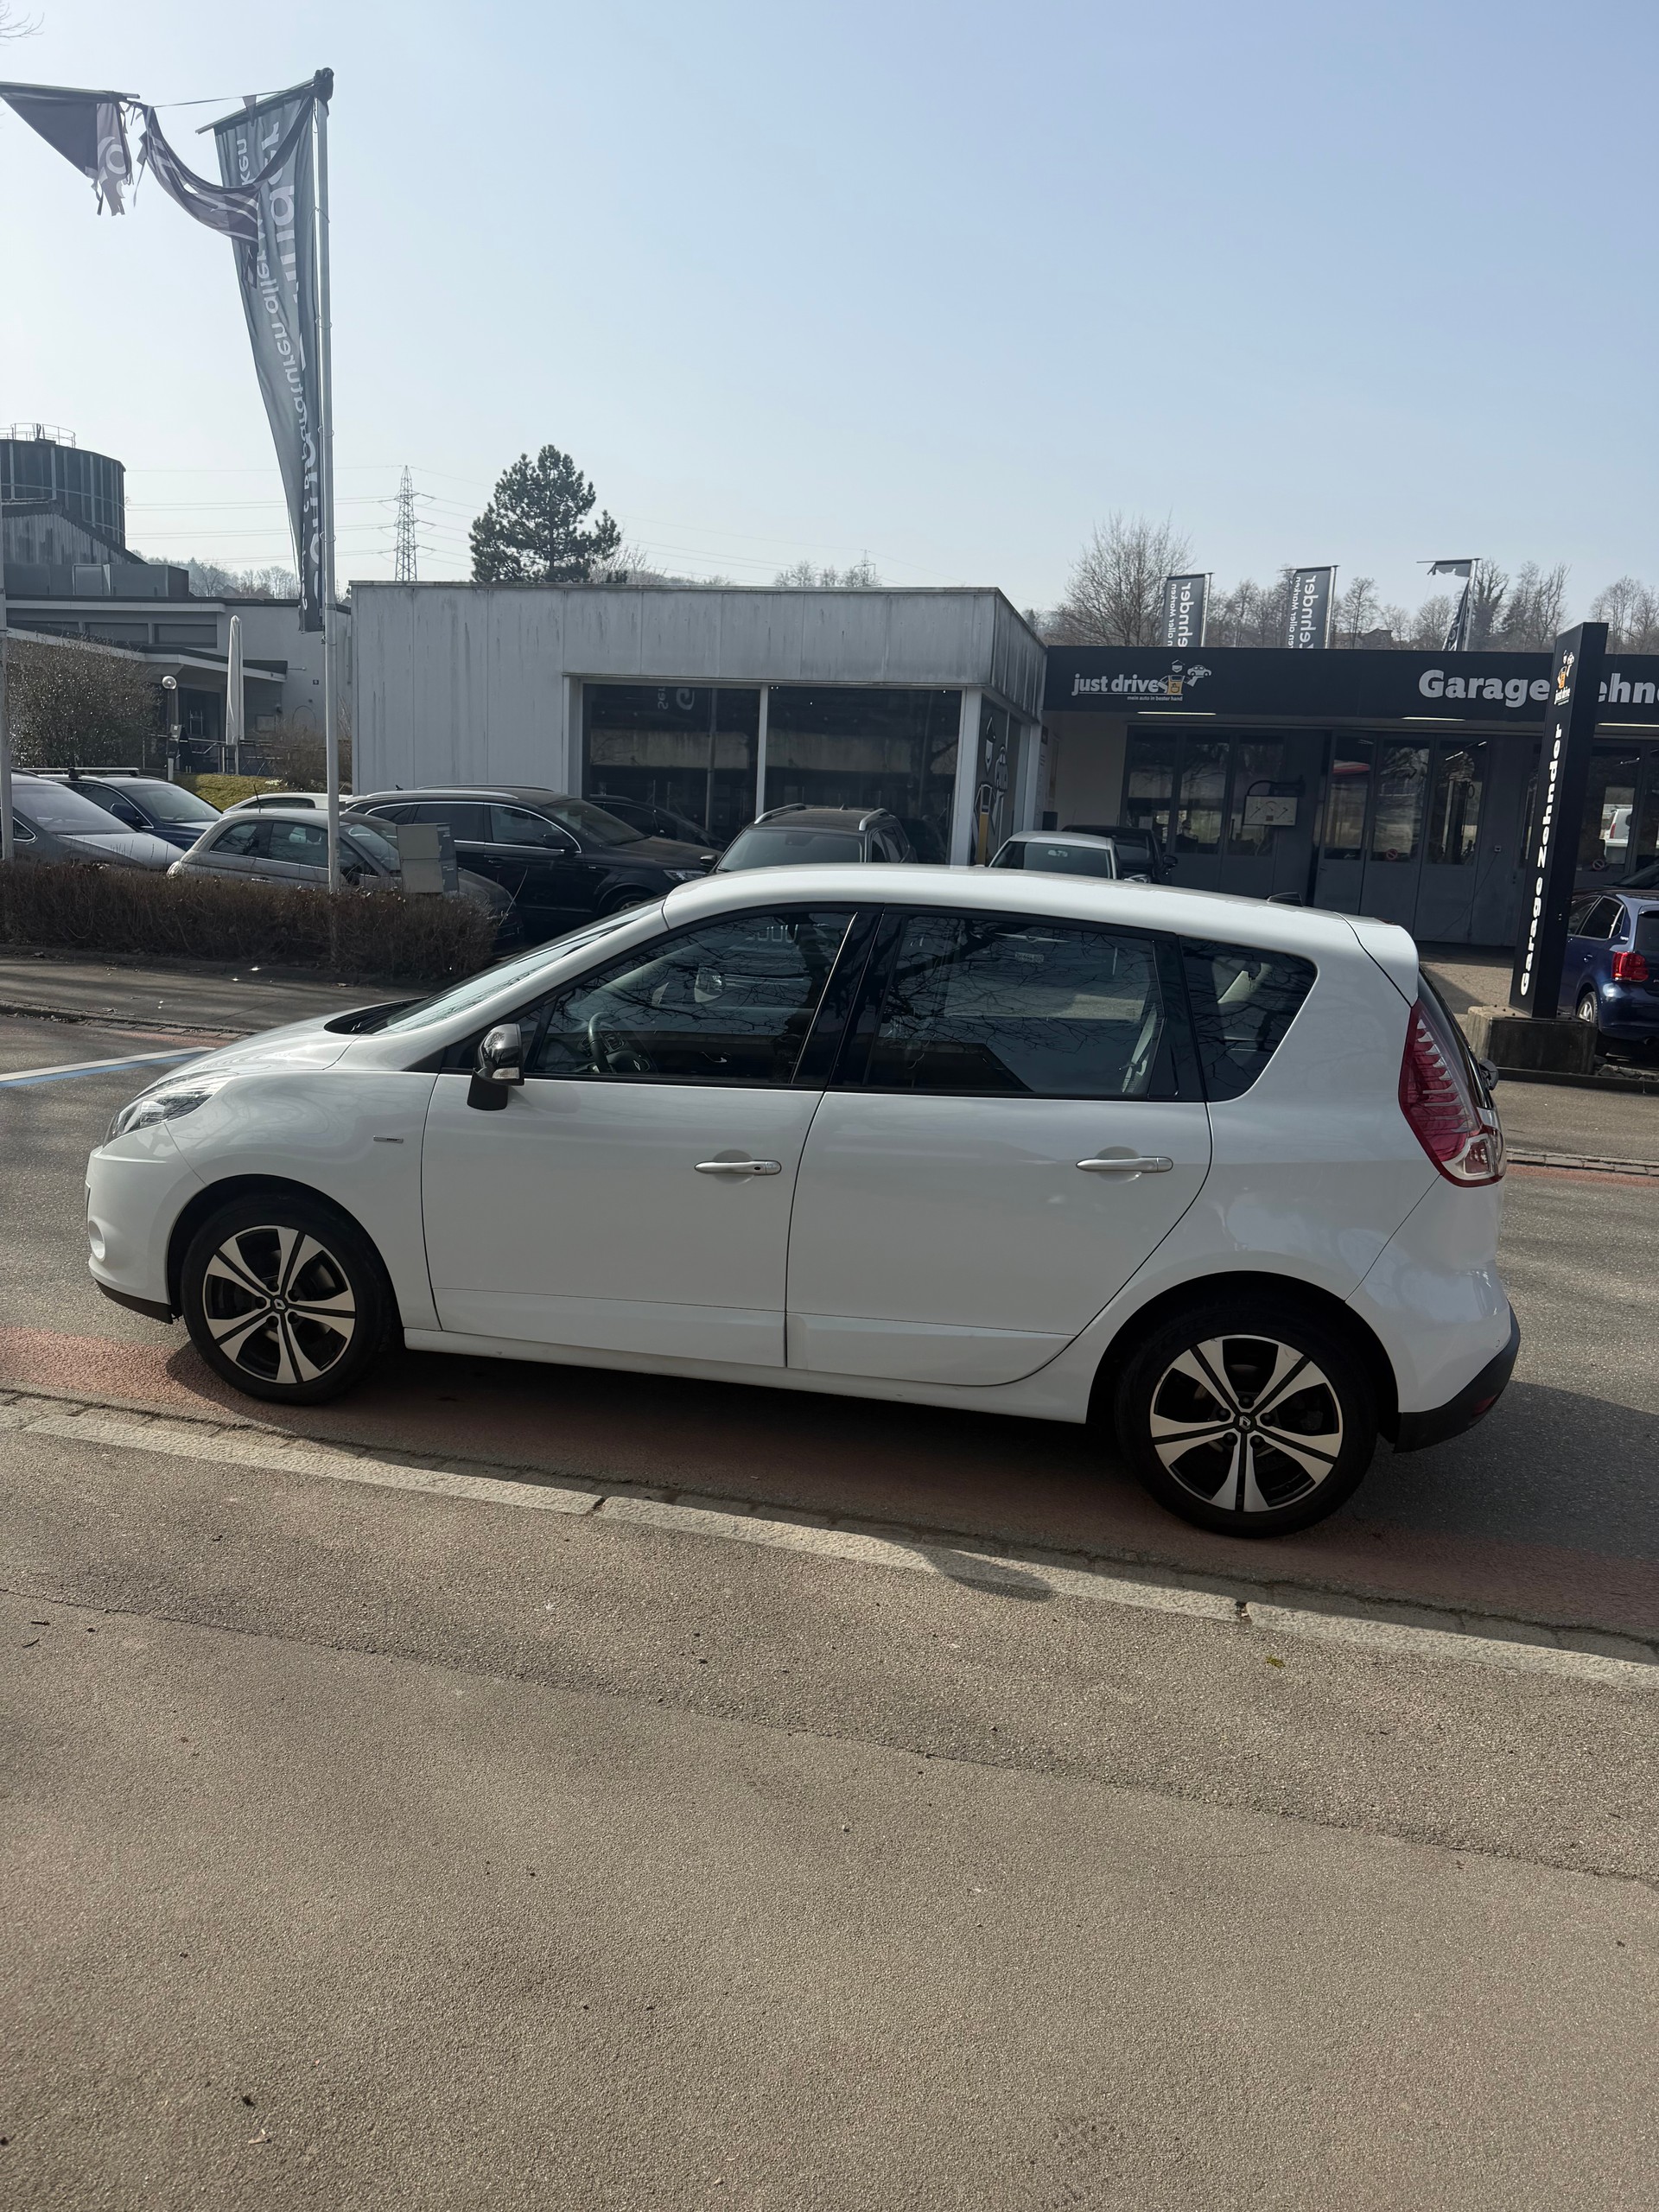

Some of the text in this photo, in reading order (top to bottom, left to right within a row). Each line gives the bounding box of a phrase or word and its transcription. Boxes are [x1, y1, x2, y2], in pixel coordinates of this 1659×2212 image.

[1071, 673, 1159, 696] just drive
[1419, 669, 1550, 708] Garage
[1520, 723, 1562, 996] Garage Zehnder
